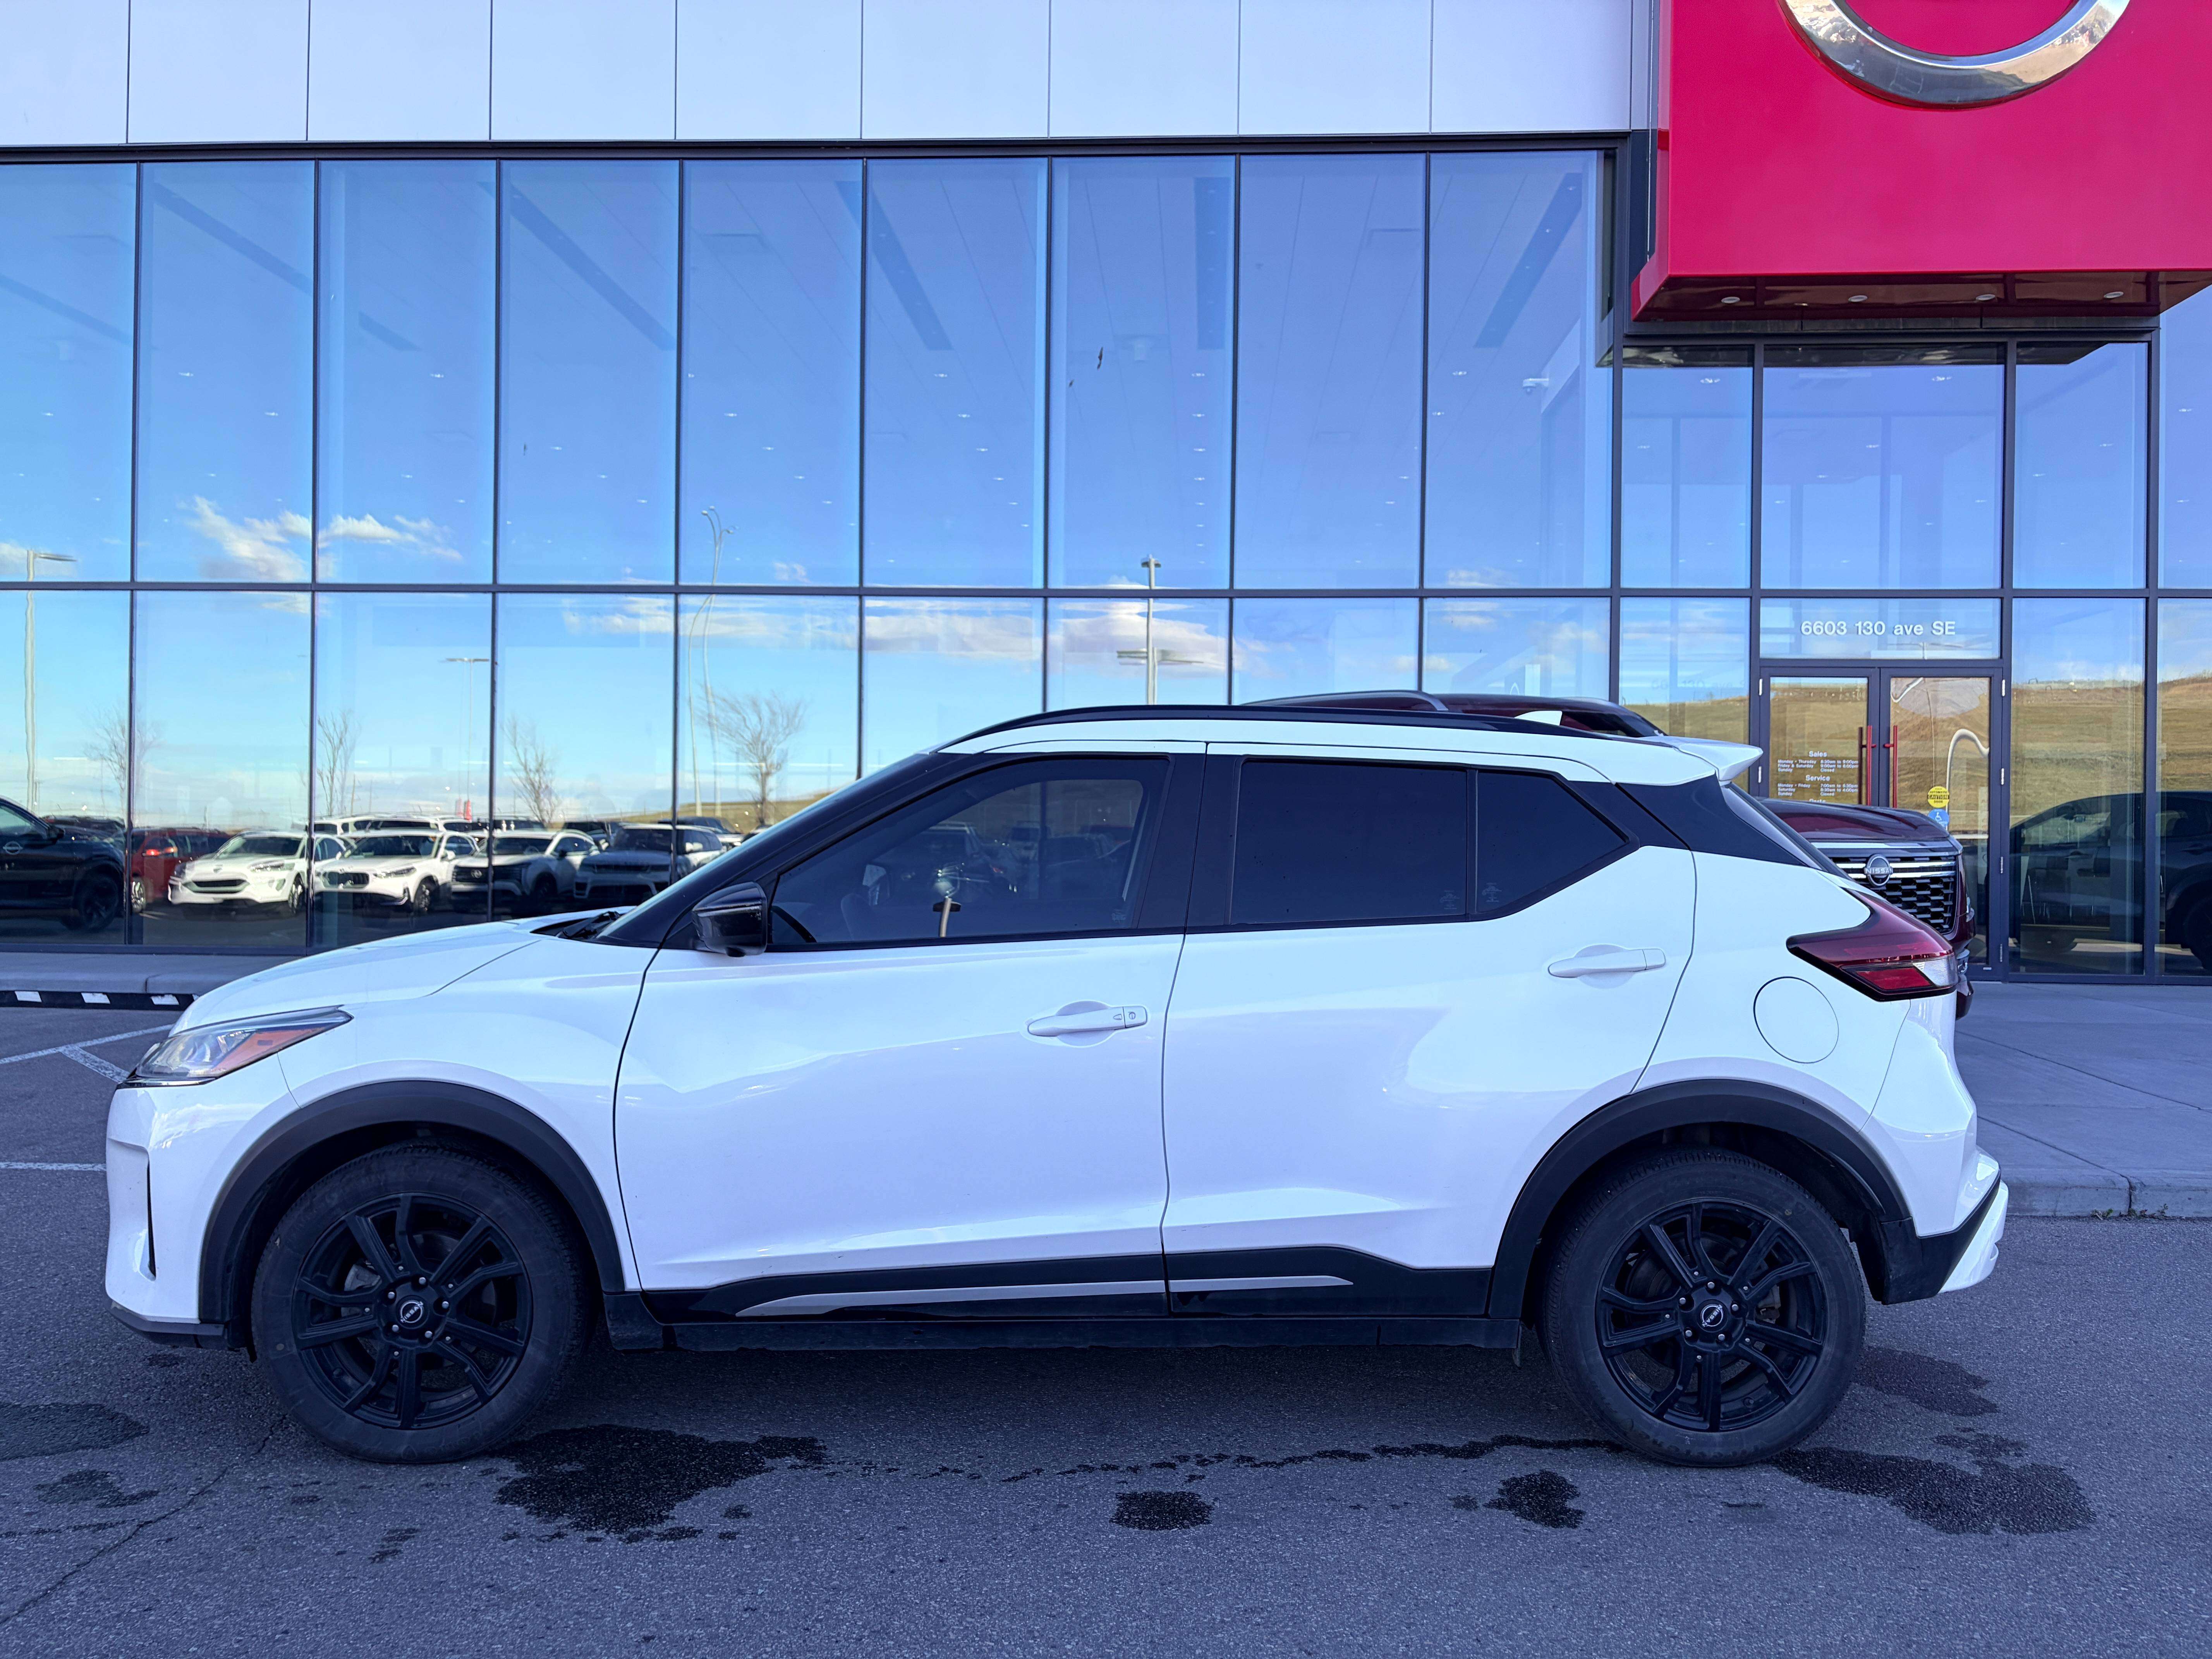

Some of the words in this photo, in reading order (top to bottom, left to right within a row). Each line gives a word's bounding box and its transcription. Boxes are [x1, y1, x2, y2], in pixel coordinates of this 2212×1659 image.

[1801, 621, 1847, 635] 6603
[1855, 621, 1886, 635] 130
[1894, 624, 1923, 635] ave
[1932, 621, 1956, 635] SE
[400, 1301, 424, 1323] NISSAN
[1702, 1304, 1723, 1327] NISSAN
